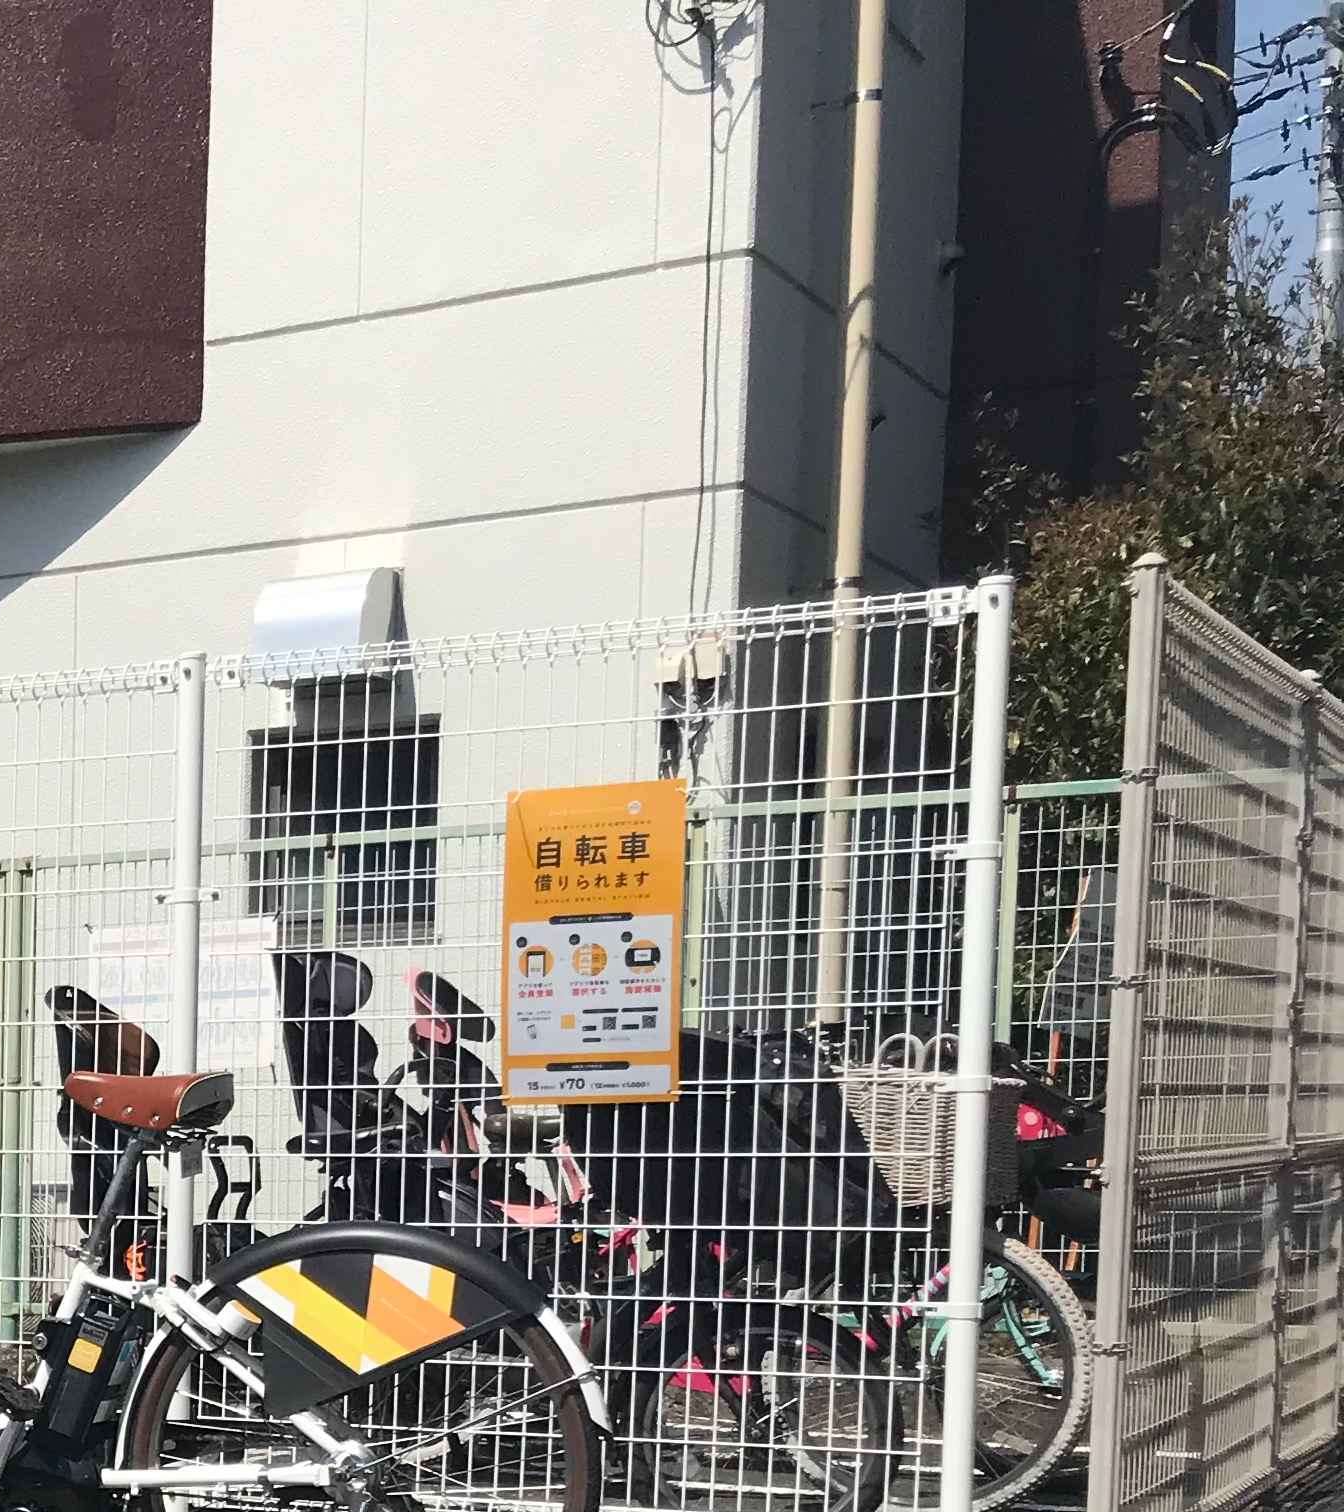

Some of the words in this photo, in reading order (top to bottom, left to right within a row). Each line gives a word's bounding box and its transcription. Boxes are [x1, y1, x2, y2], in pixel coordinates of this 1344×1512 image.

[535, 831, 651, 870] 自転車
[534, 871, 651, 892] 借りられます
[527, 1081, 539, 1091] 15
[559, 1078, 585, 1090] ¥70
